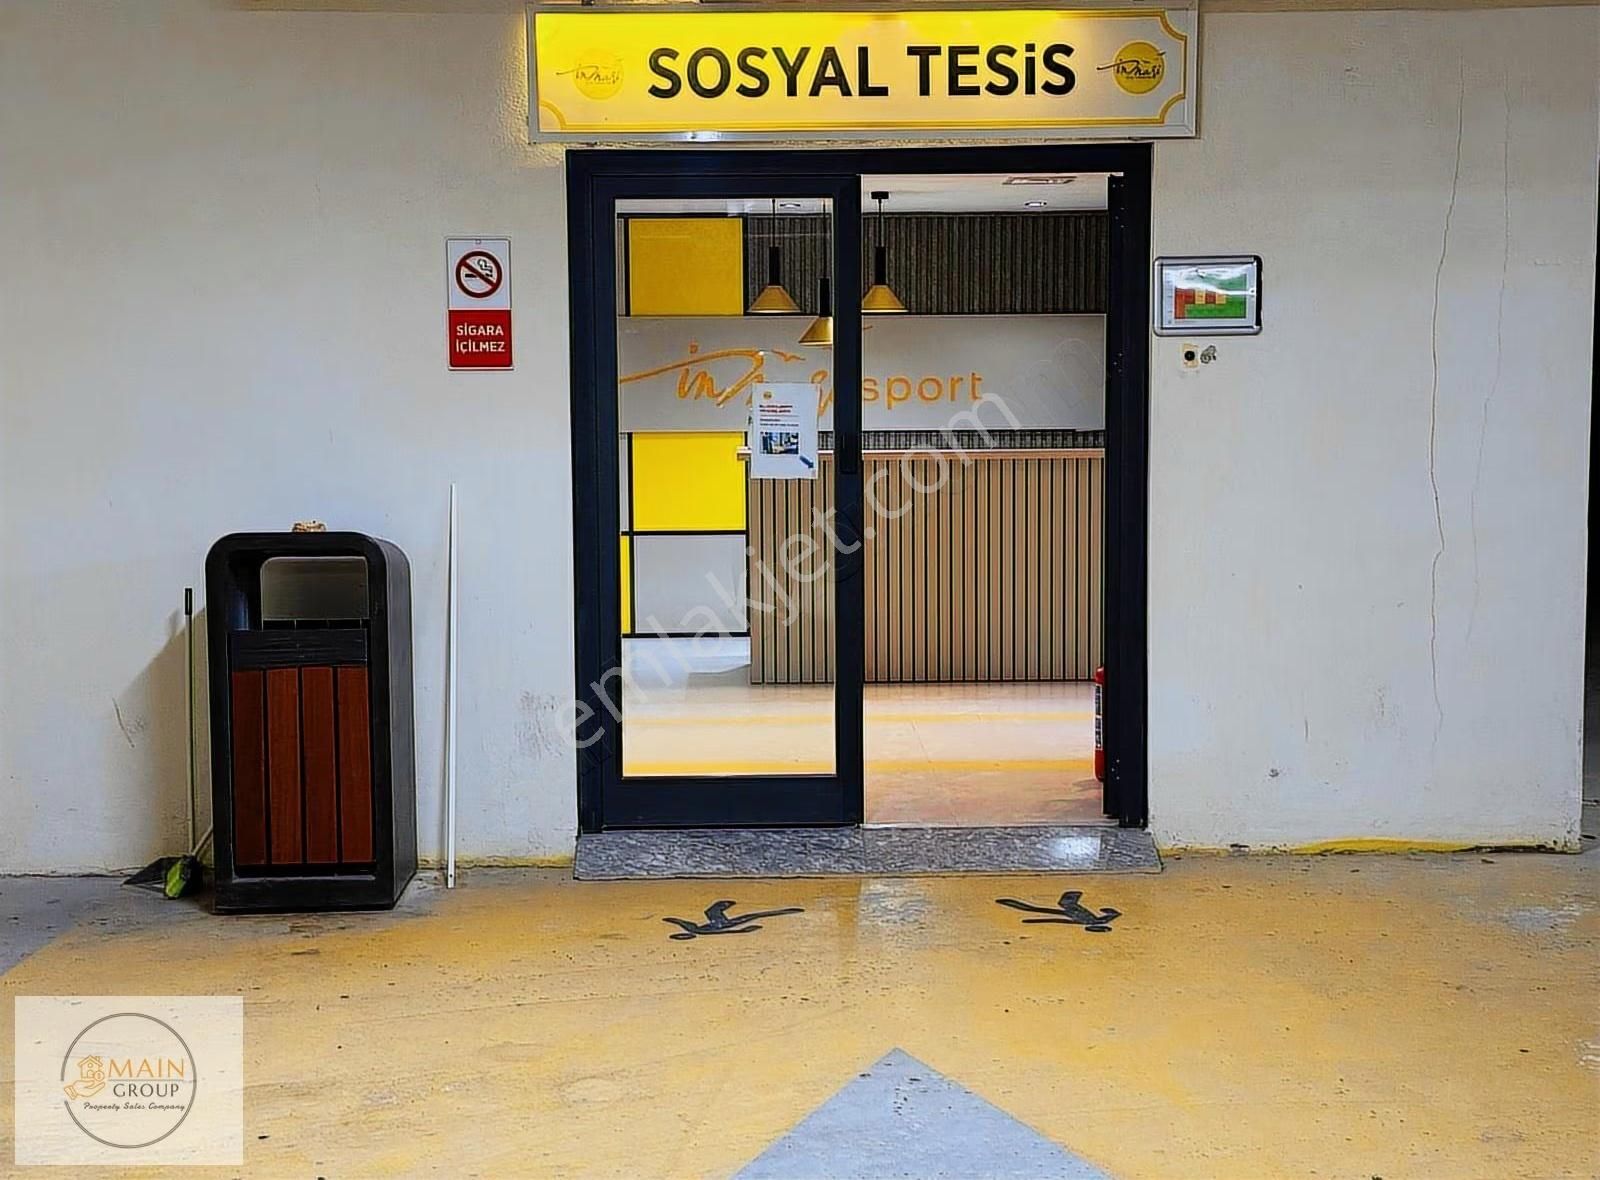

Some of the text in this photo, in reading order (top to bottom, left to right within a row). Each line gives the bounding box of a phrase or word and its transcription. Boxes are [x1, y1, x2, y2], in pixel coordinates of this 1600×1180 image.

[648, 46, 888, 98] SOSYAL
[456, 322, 504, 336] SİGARA
[455, 339, 505, 355] İÇİLMEZ
[863, 372, 983, 410] sport
